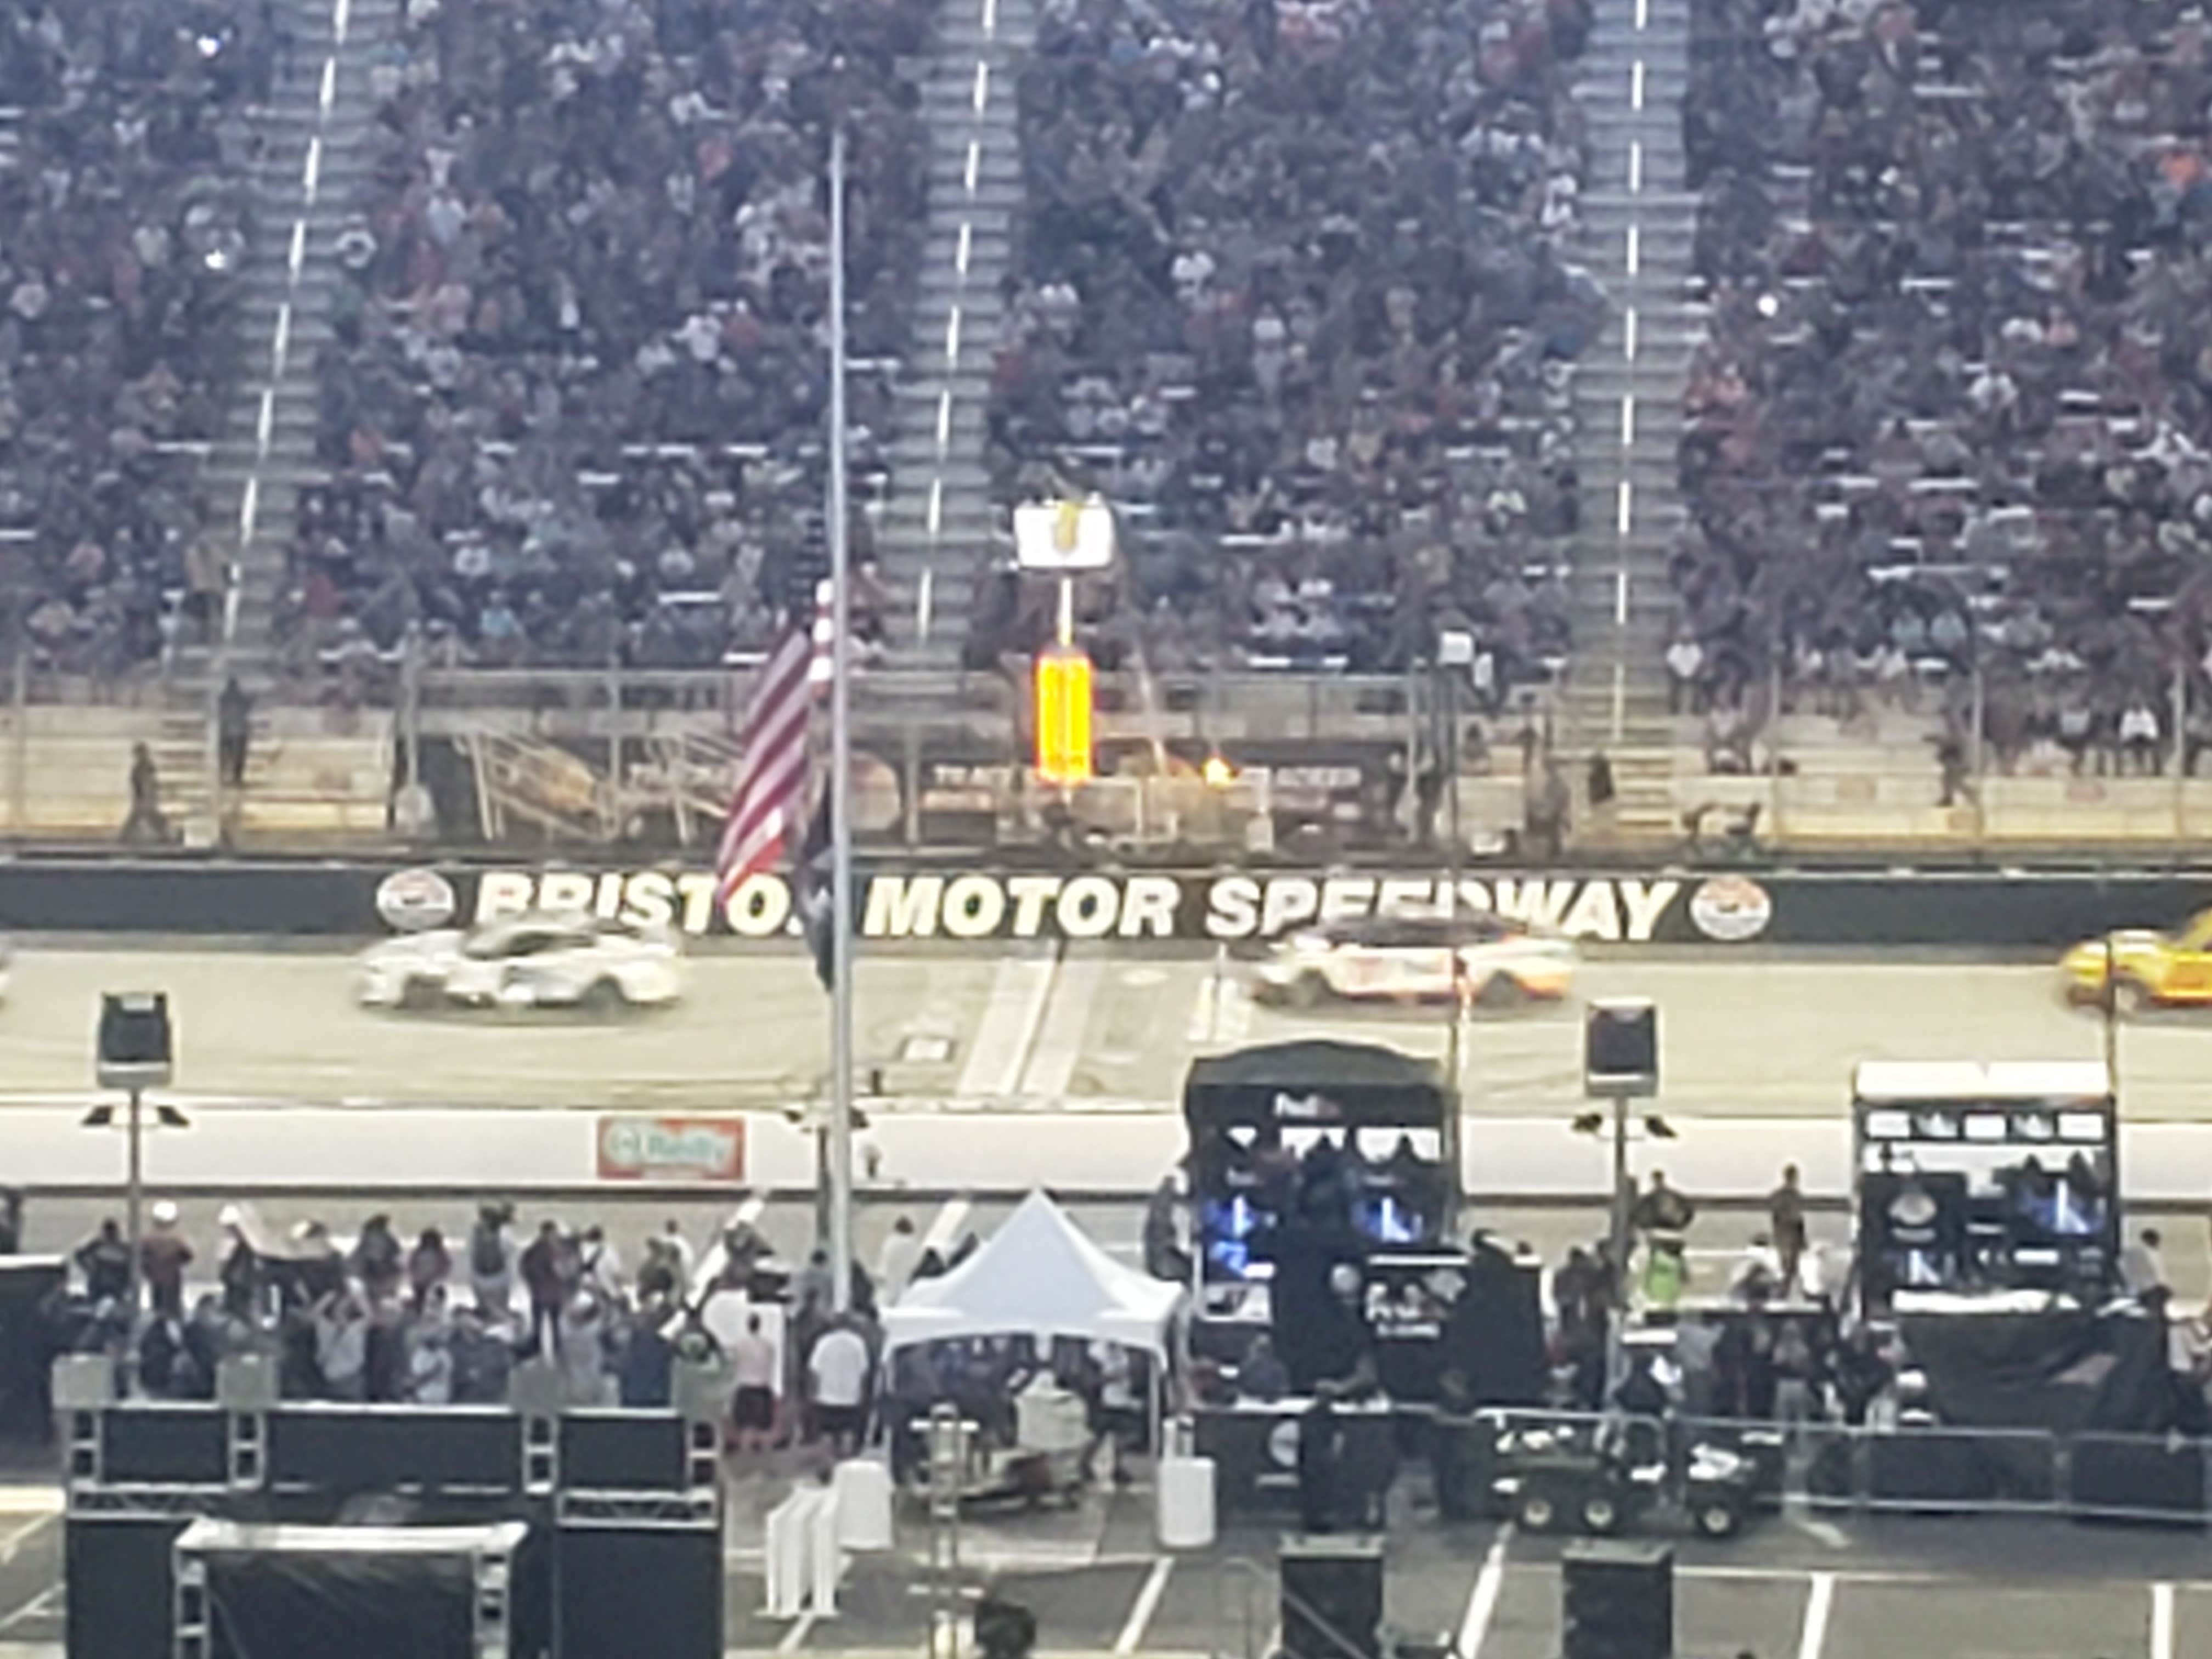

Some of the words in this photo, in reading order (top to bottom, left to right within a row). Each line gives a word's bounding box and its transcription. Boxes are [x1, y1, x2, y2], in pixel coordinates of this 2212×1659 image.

[476, 872, 803, 936] BRISTO
[863, 876, 1180, 936] MOTOR
[1205, 878, 1680, 938] SPEEDWAY
